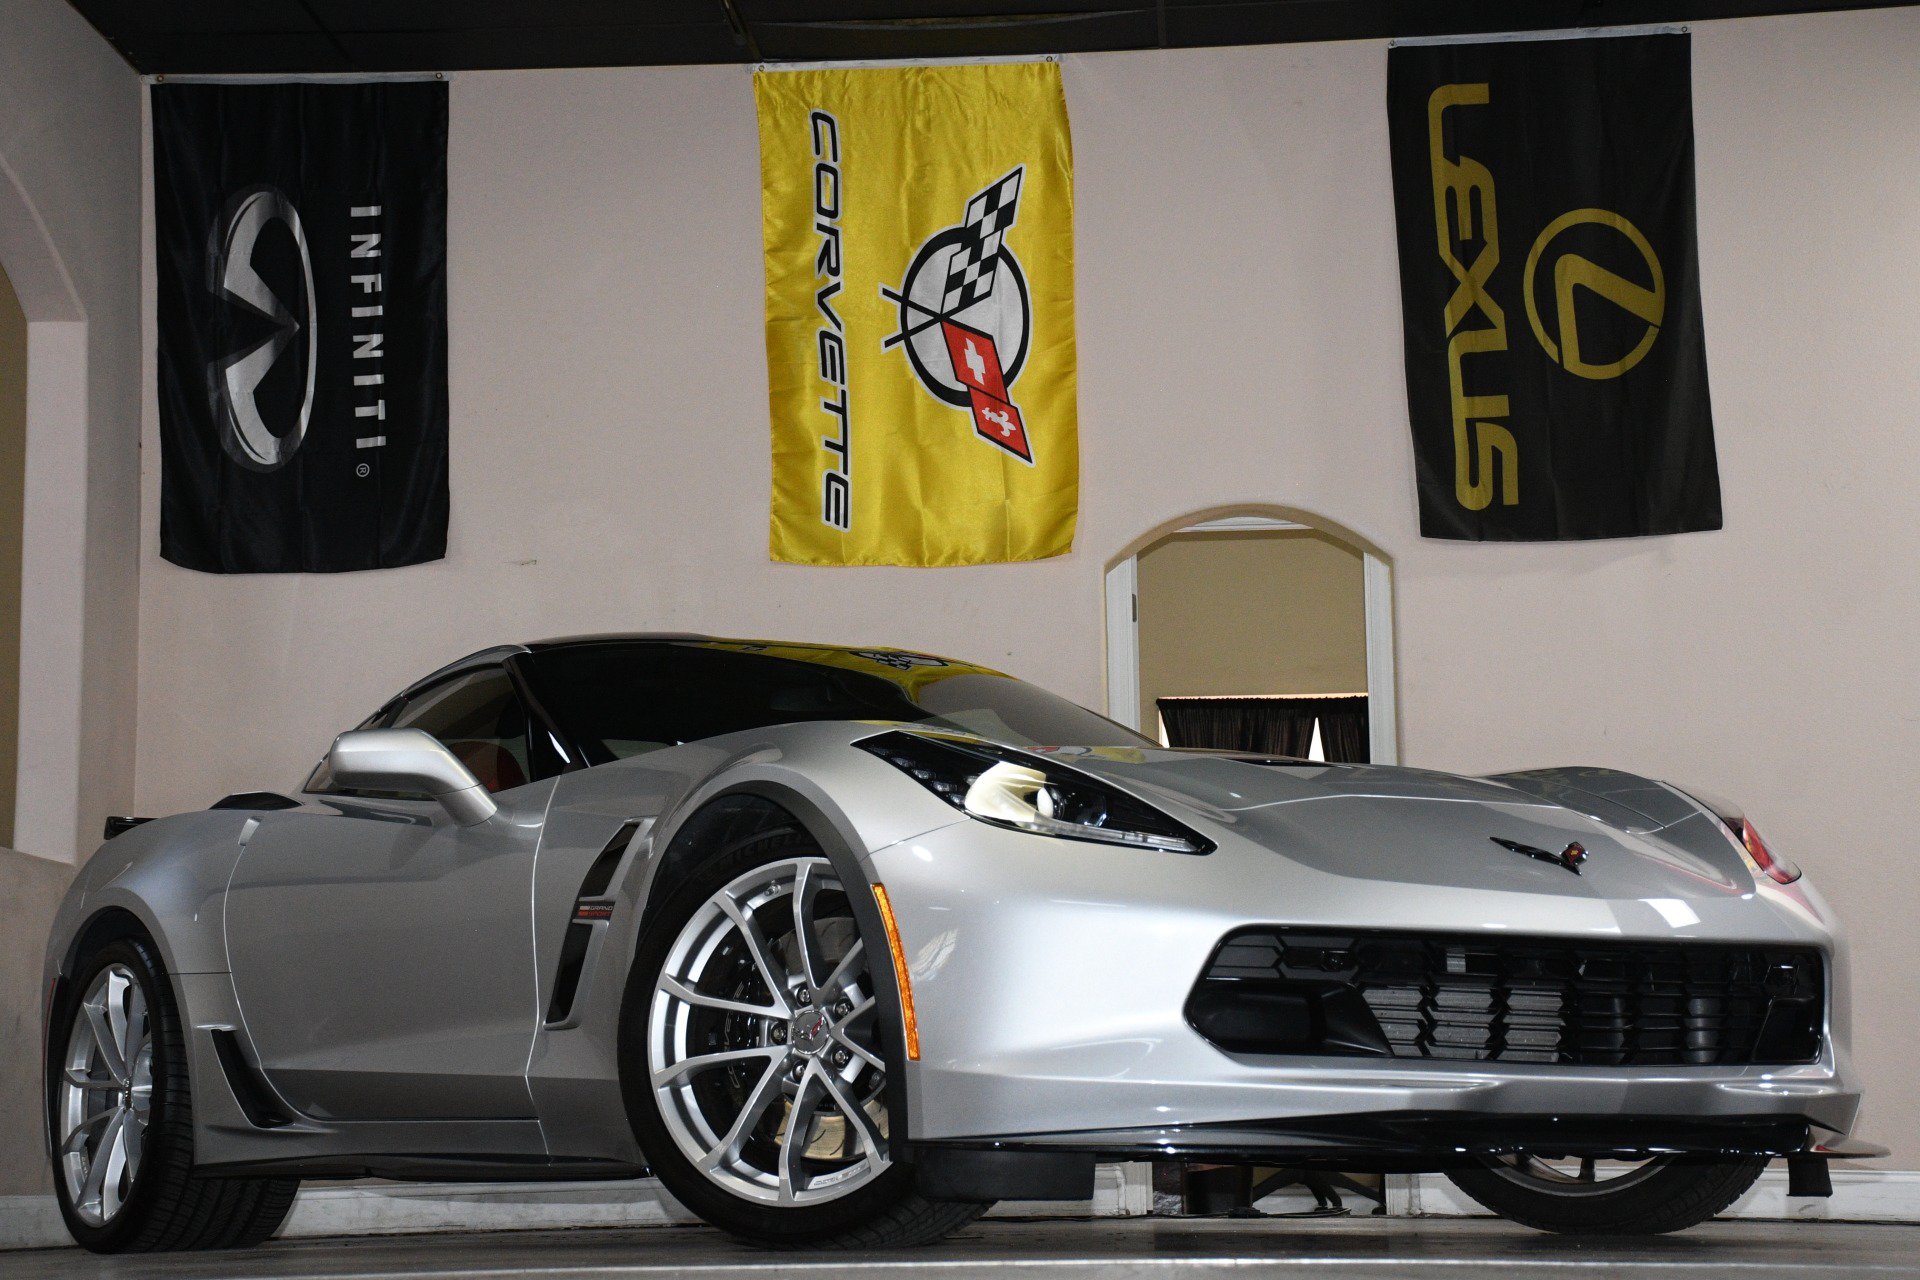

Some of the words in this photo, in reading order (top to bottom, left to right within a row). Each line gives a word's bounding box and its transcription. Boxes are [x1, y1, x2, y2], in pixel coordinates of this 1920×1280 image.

[350, 205, 387, 450] INFINITI
[811, 109, 852, 531] CORVETTE
[1427, 82, 1519, 511] LEXUS
